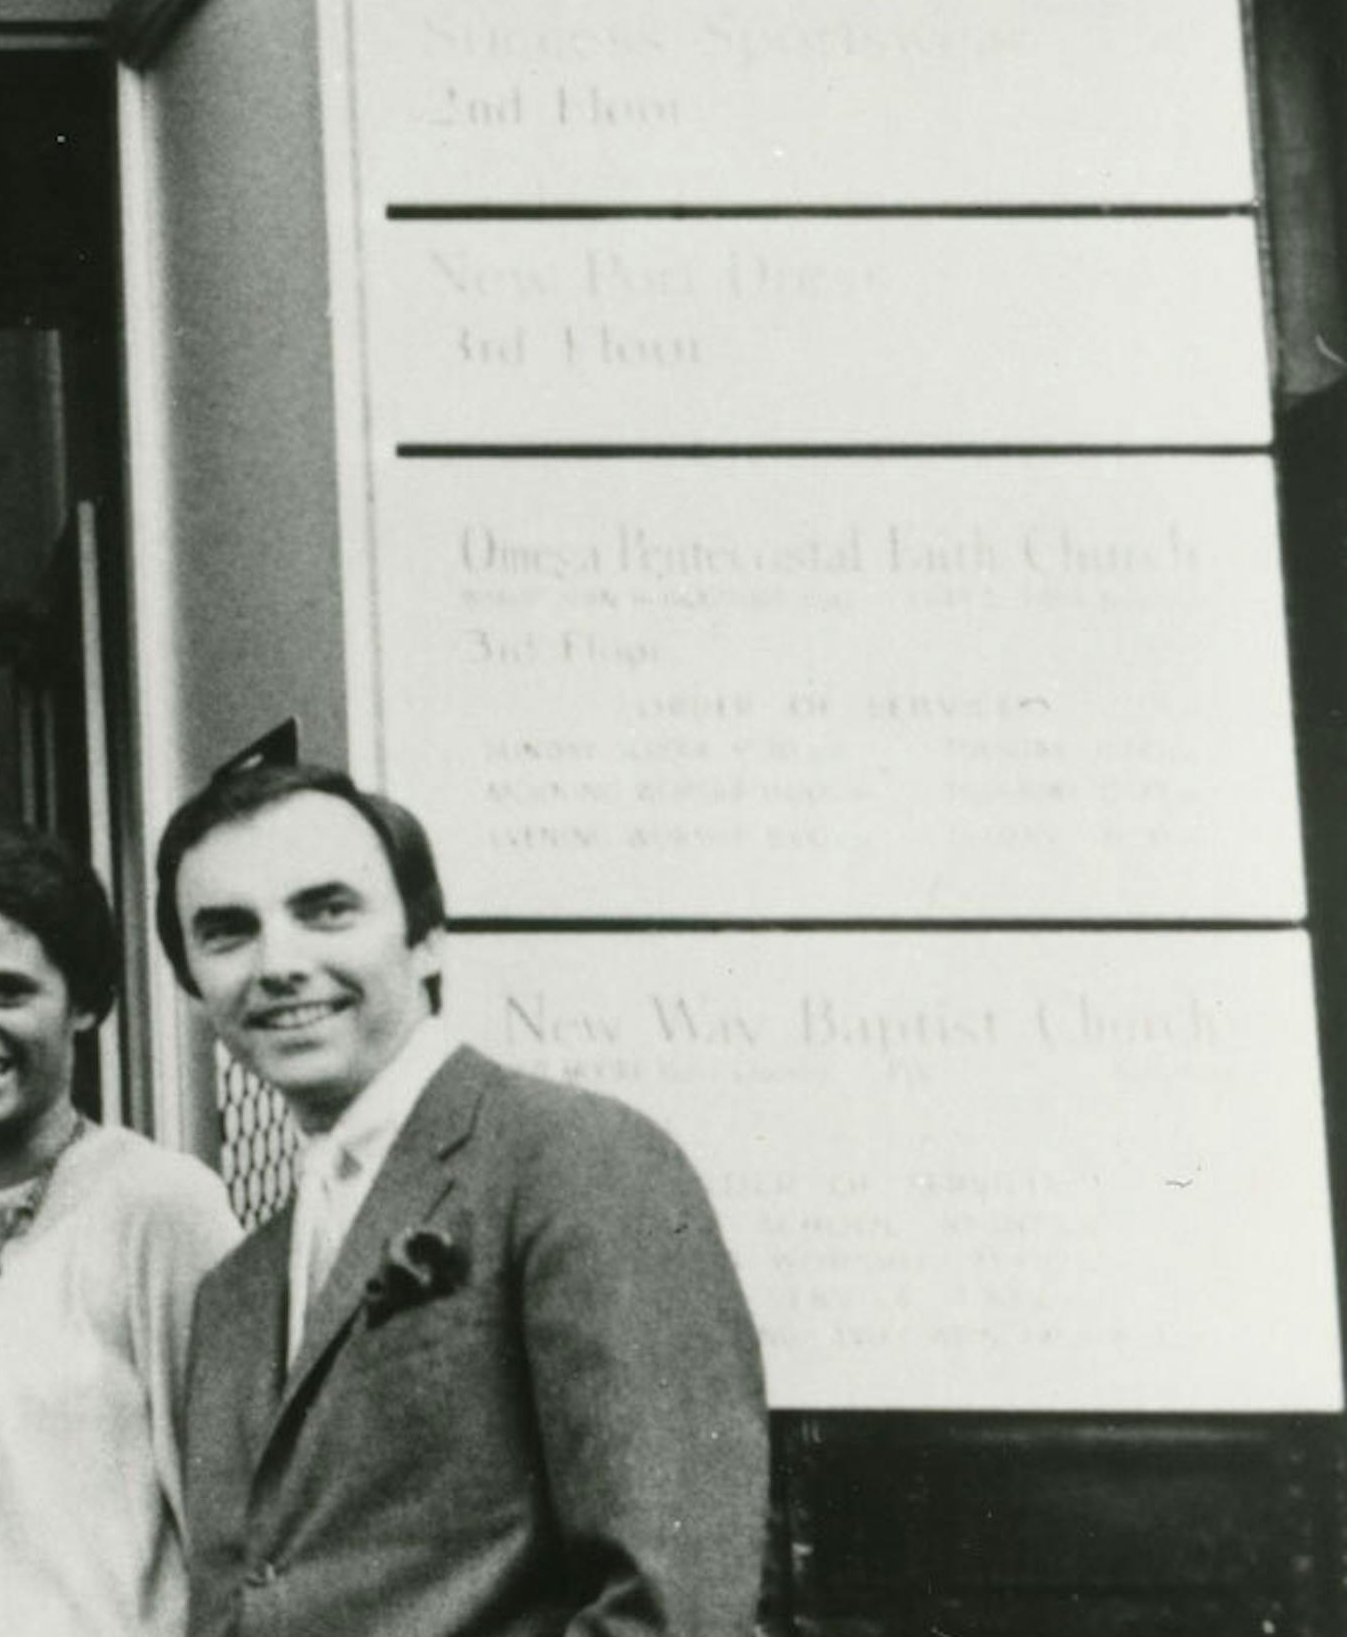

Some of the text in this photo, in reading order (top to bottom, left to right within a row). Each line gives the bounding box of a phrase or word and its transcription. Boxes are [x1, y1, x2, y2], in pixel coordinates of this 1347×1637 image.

[429, 84, 681, 126] 2nd Floor
[456, 323, 703, 366] 3rd Floor
[459, 522, 1200, 581] Omega Pentecostal Faith Church
[466, 628, 537, 665] 3rd
[501, 990, 1223, 1053] New Way Baptist Church
